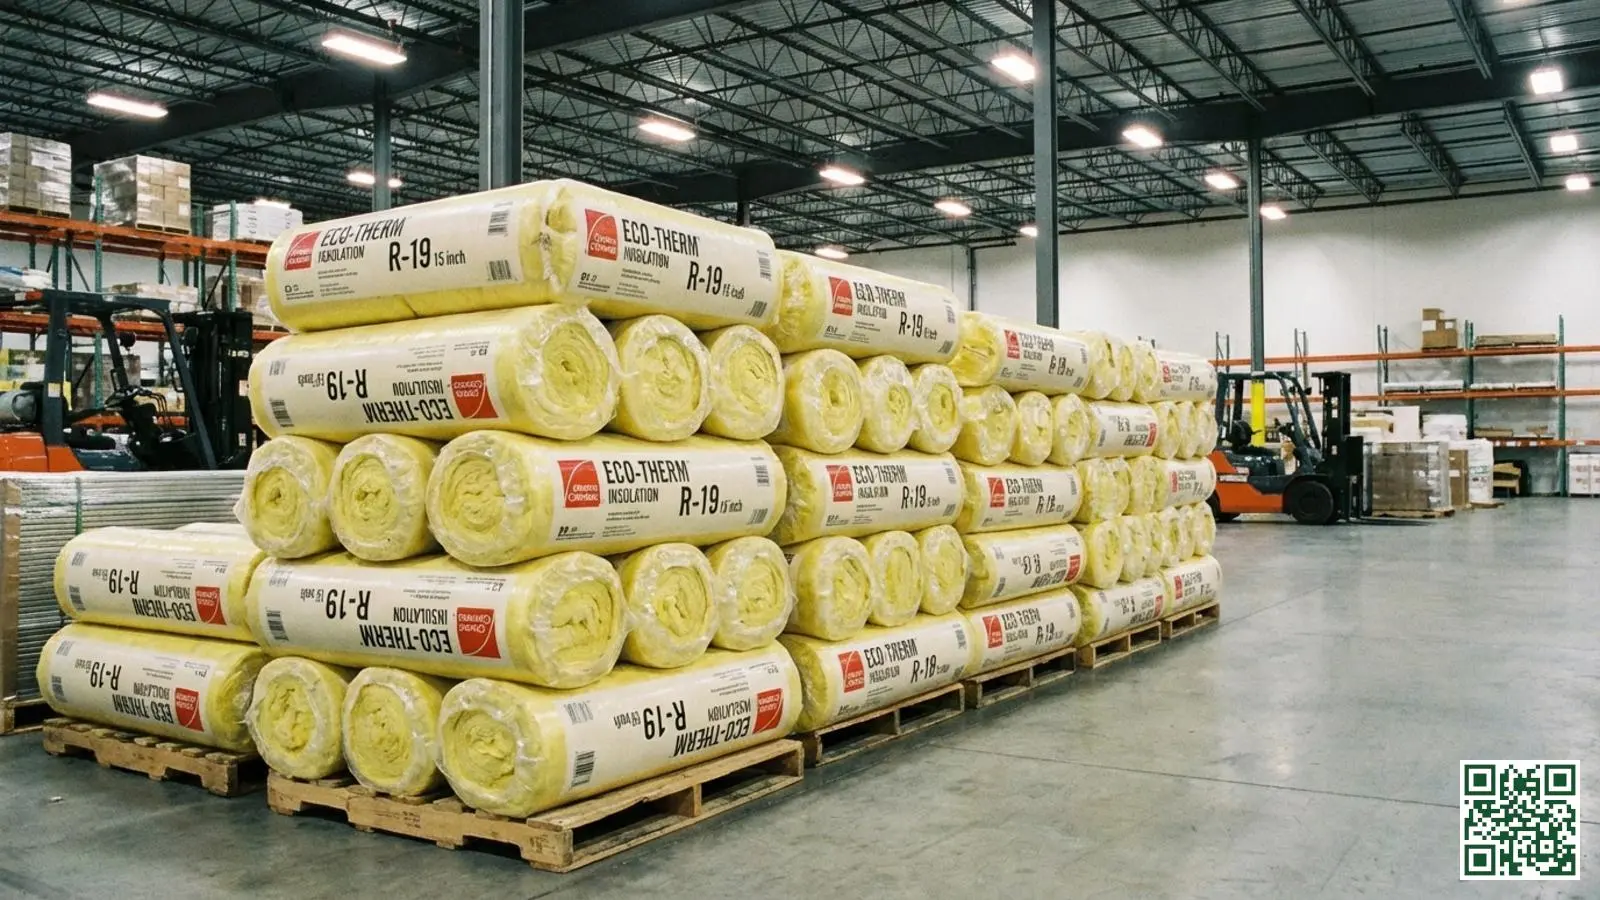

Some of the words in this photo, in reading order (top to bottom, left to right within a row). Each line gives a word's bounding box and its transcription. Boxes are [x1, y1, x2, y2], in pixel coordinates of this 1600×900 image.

[621, 218, 699, 257] ECO-THERM
[388, 237, 431, 272] R-19
[434, 251, 445, 266] 15
[446, 249, 466, 266] inch
[686, 261, 723, 295] R-19
[327, 369, 368, 400] R-19
[363, 398, 454, 424] ECO-THERM
[602, 460, 690, 485] ECO-THERM
[679, 485, 719, 516] R-19
[108, 568, 139, 595] R-19
[326, 589, 371, 620] R-19
[393, 607, 448, 625] INSULATION
[360, 624, 453, 653] ECO-THERM
[90, 662, 122, 690] R-19
[643, 700, 687, 740] R-19
[674, 715, 752, 757] ECO-THERM
